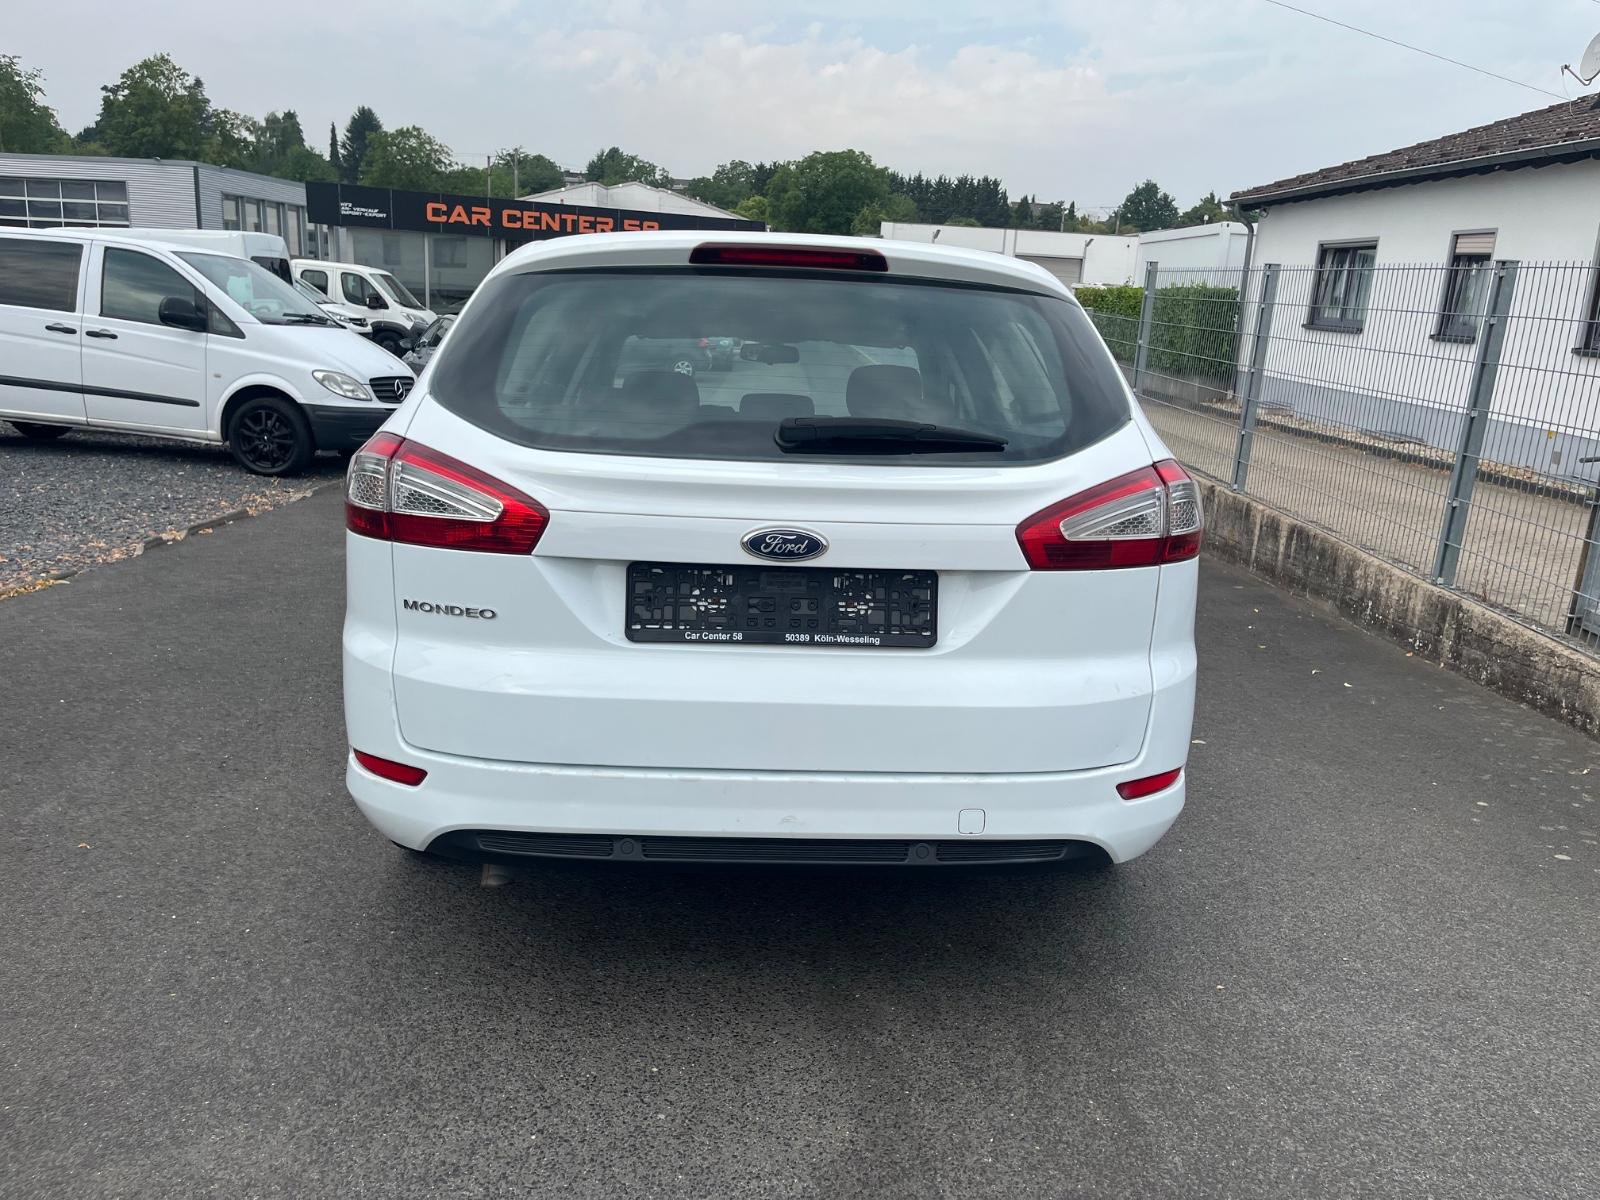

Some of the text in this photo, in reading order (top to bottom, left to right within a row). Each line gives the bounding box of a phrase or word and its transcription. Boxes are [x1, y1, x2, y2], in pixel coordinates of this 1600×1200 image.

[426, 202, 492, 227] CAR
[502, 209, 614, 233] CENTER
[760, 533, 809, 554] Ford
[403, 598, 497, 619] MONDEO
[684, 631, 743, 641] Car Center 58
[784, 633, 880, 646] 50389 Köln-Wesseling
